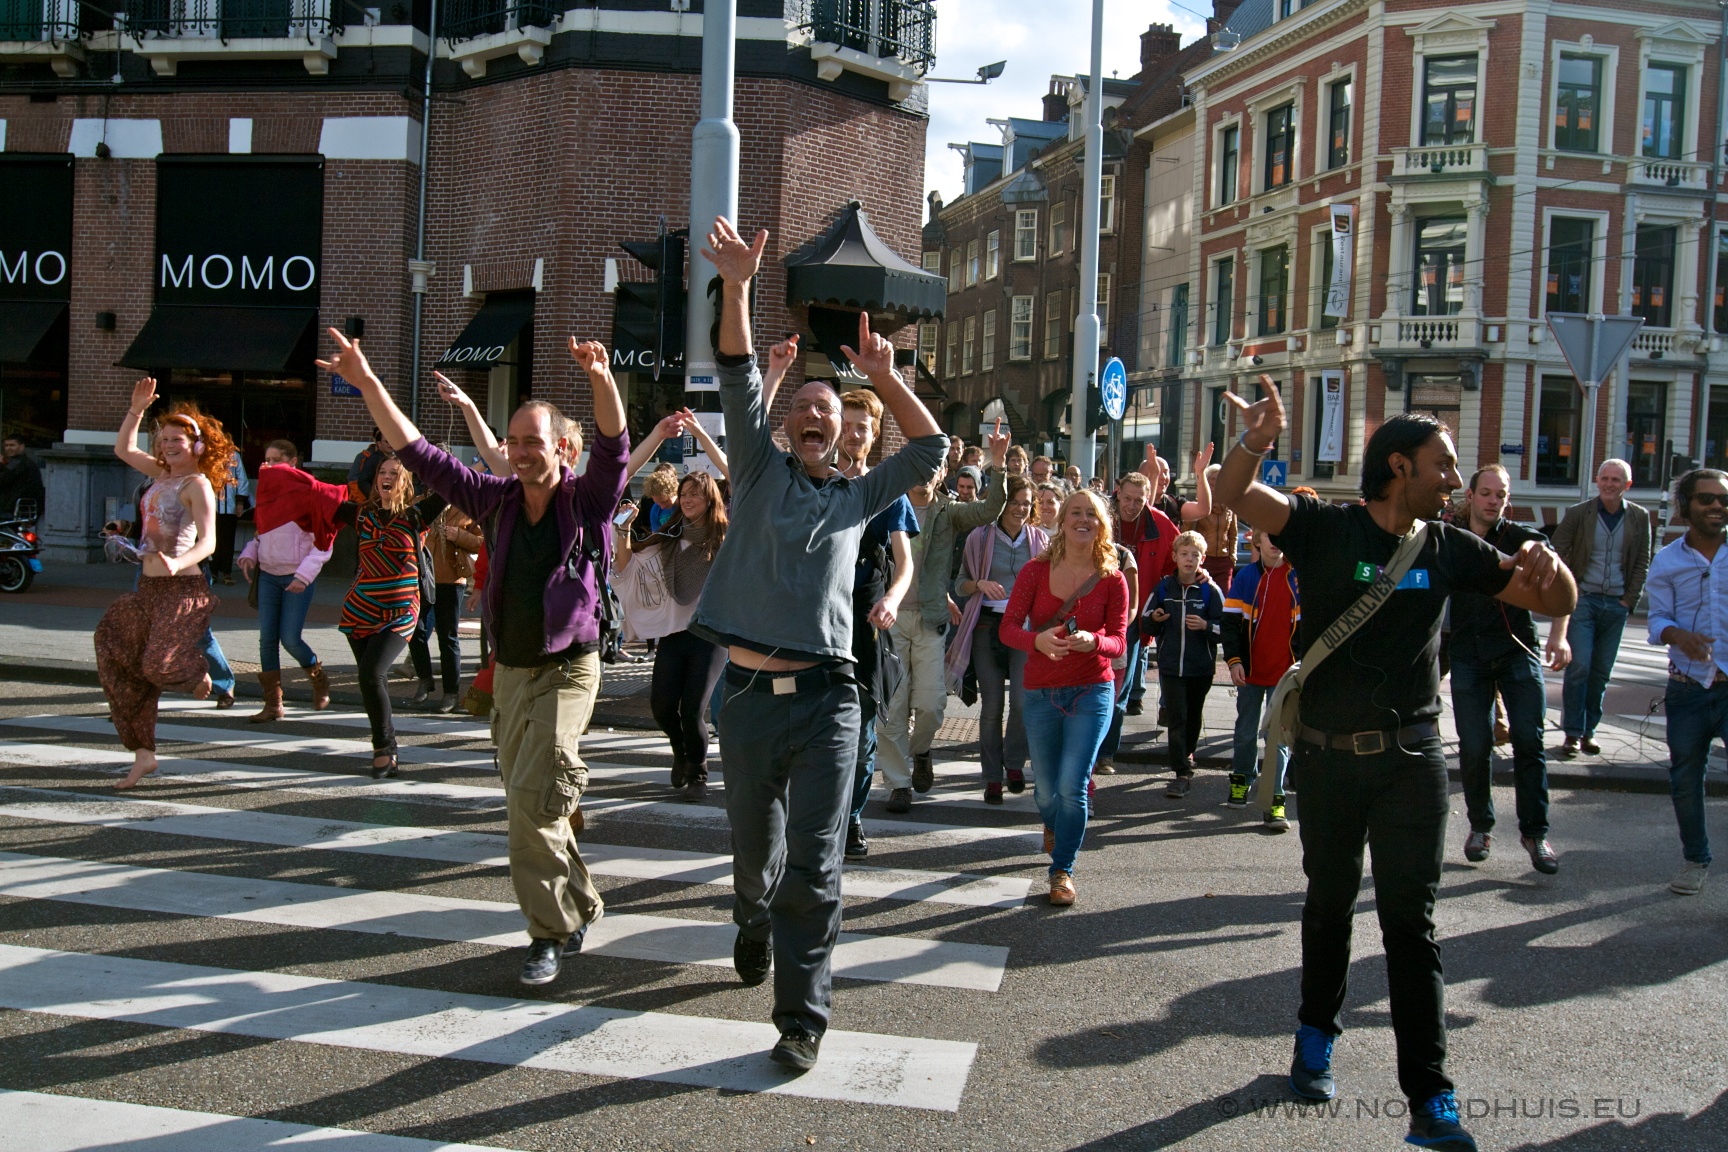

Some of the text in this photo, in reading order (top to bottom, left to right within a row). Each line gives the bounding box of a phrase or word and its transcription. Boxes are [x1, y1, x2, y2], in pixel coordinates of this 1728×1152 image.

[1338, 236, 1346, 282] Restaurant
[161, 254, 316, 291] MOMO
[438, 345, 505, 362] MOMO
[334, 386, 351, 394] KADE
[1327, 394, 1340, 402] BAR
[1362, 566, 1371, 577] S
[1415, 572, 1423, 583] F
[1321, 573, 1396, 650] QUIKSILVER
